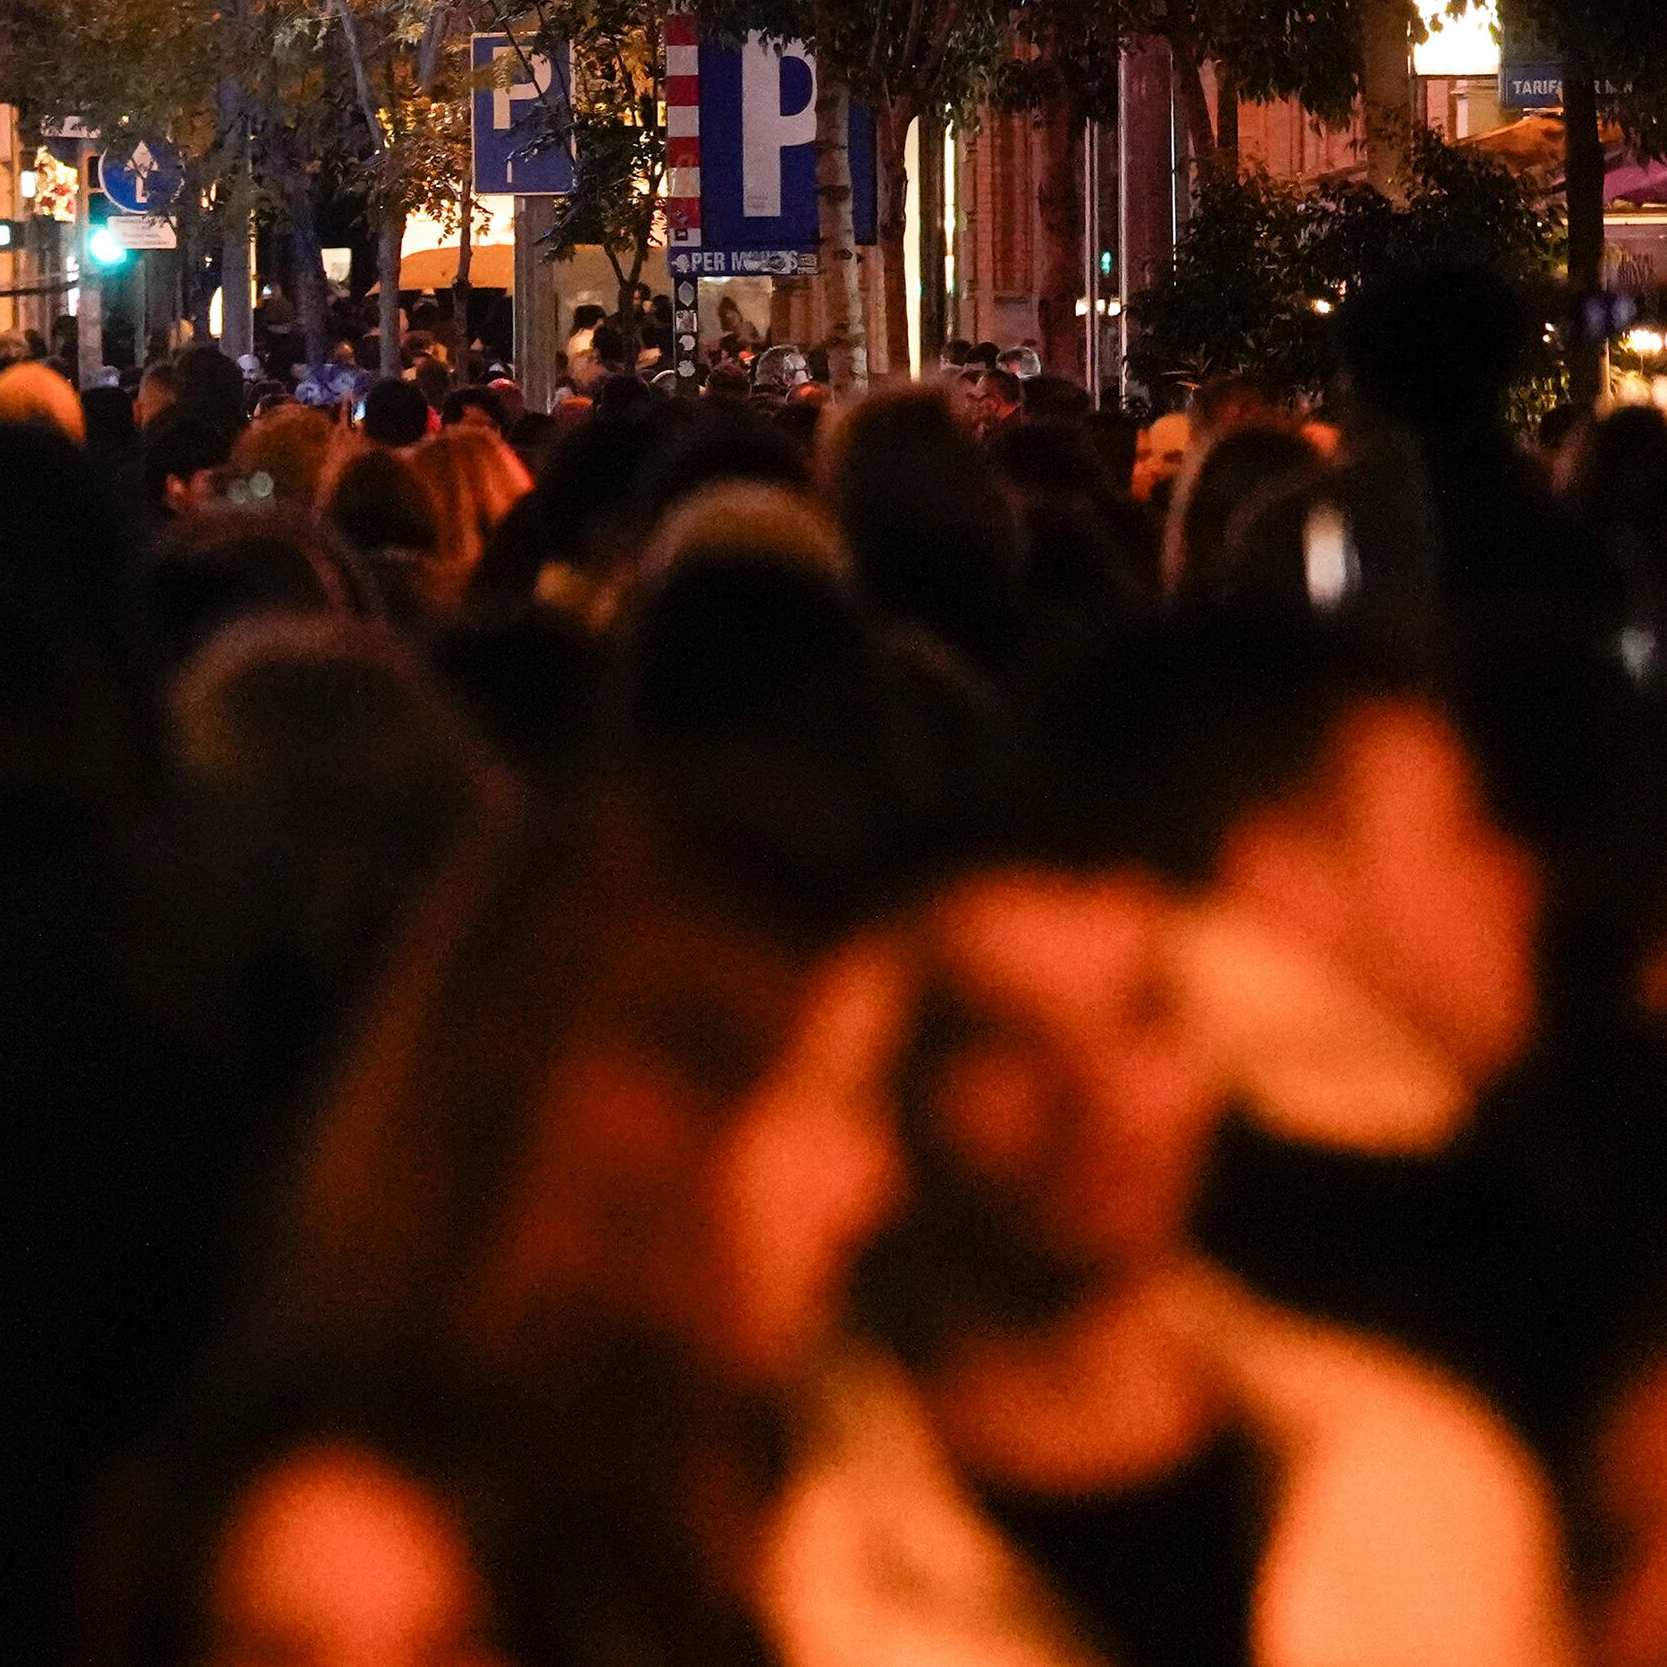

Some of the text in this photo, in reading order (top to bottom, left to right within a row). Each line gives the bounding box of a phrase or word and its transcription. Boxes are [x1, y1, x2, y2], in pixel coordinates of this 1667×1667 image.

[492, 45, 553, 131] P
[741, 27, 818, 218] P
[691, 251, 725, 272] PER
